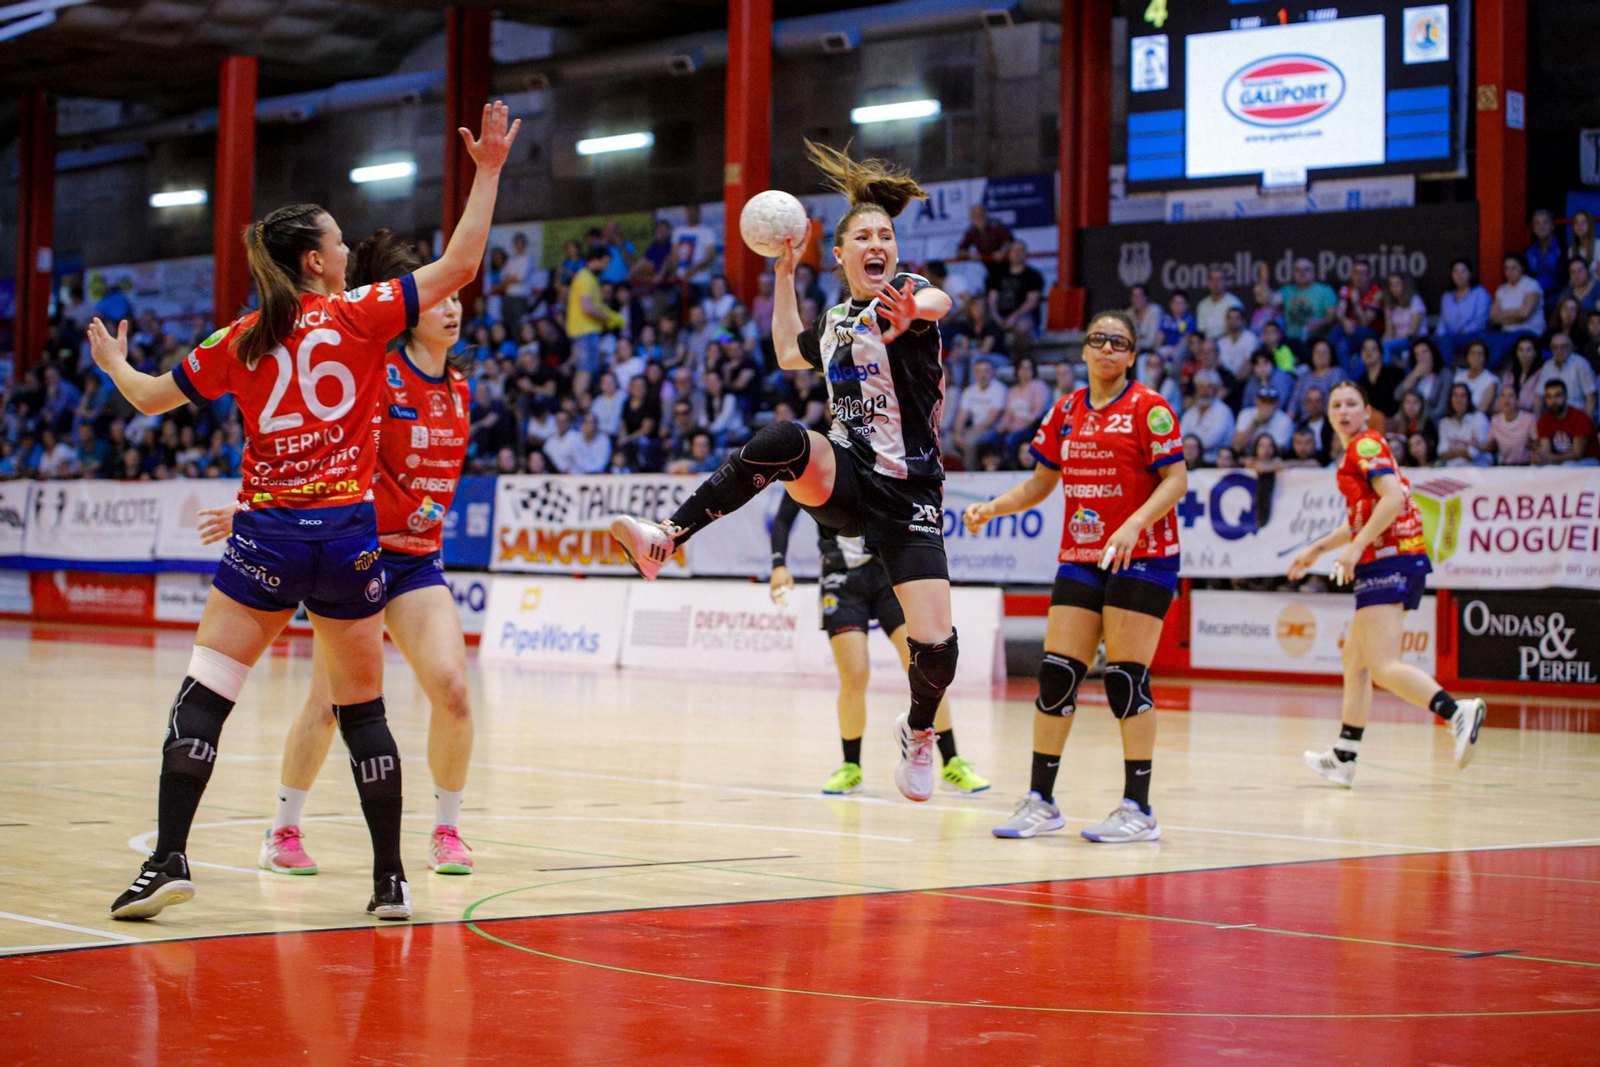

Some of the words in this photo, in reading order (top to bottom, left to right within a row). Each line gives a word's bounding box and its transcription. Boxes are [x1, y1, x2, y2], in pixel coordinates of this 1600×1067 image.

[1144, 0, 1168, 28] 4
[1240, 83, 1328, 106] GALIPORT
[245, 327, 356, 435] 26
[1103, 413, 1133, 434] 23
[912, 502, 939, 524] 20
[693, 610, 798, 631] DEPUTACIÓN
[1197, 618, 1272, 638] Recambios
[500, 620, 601, 656] PipeWorks
[360, 755, 395, 783] UP
